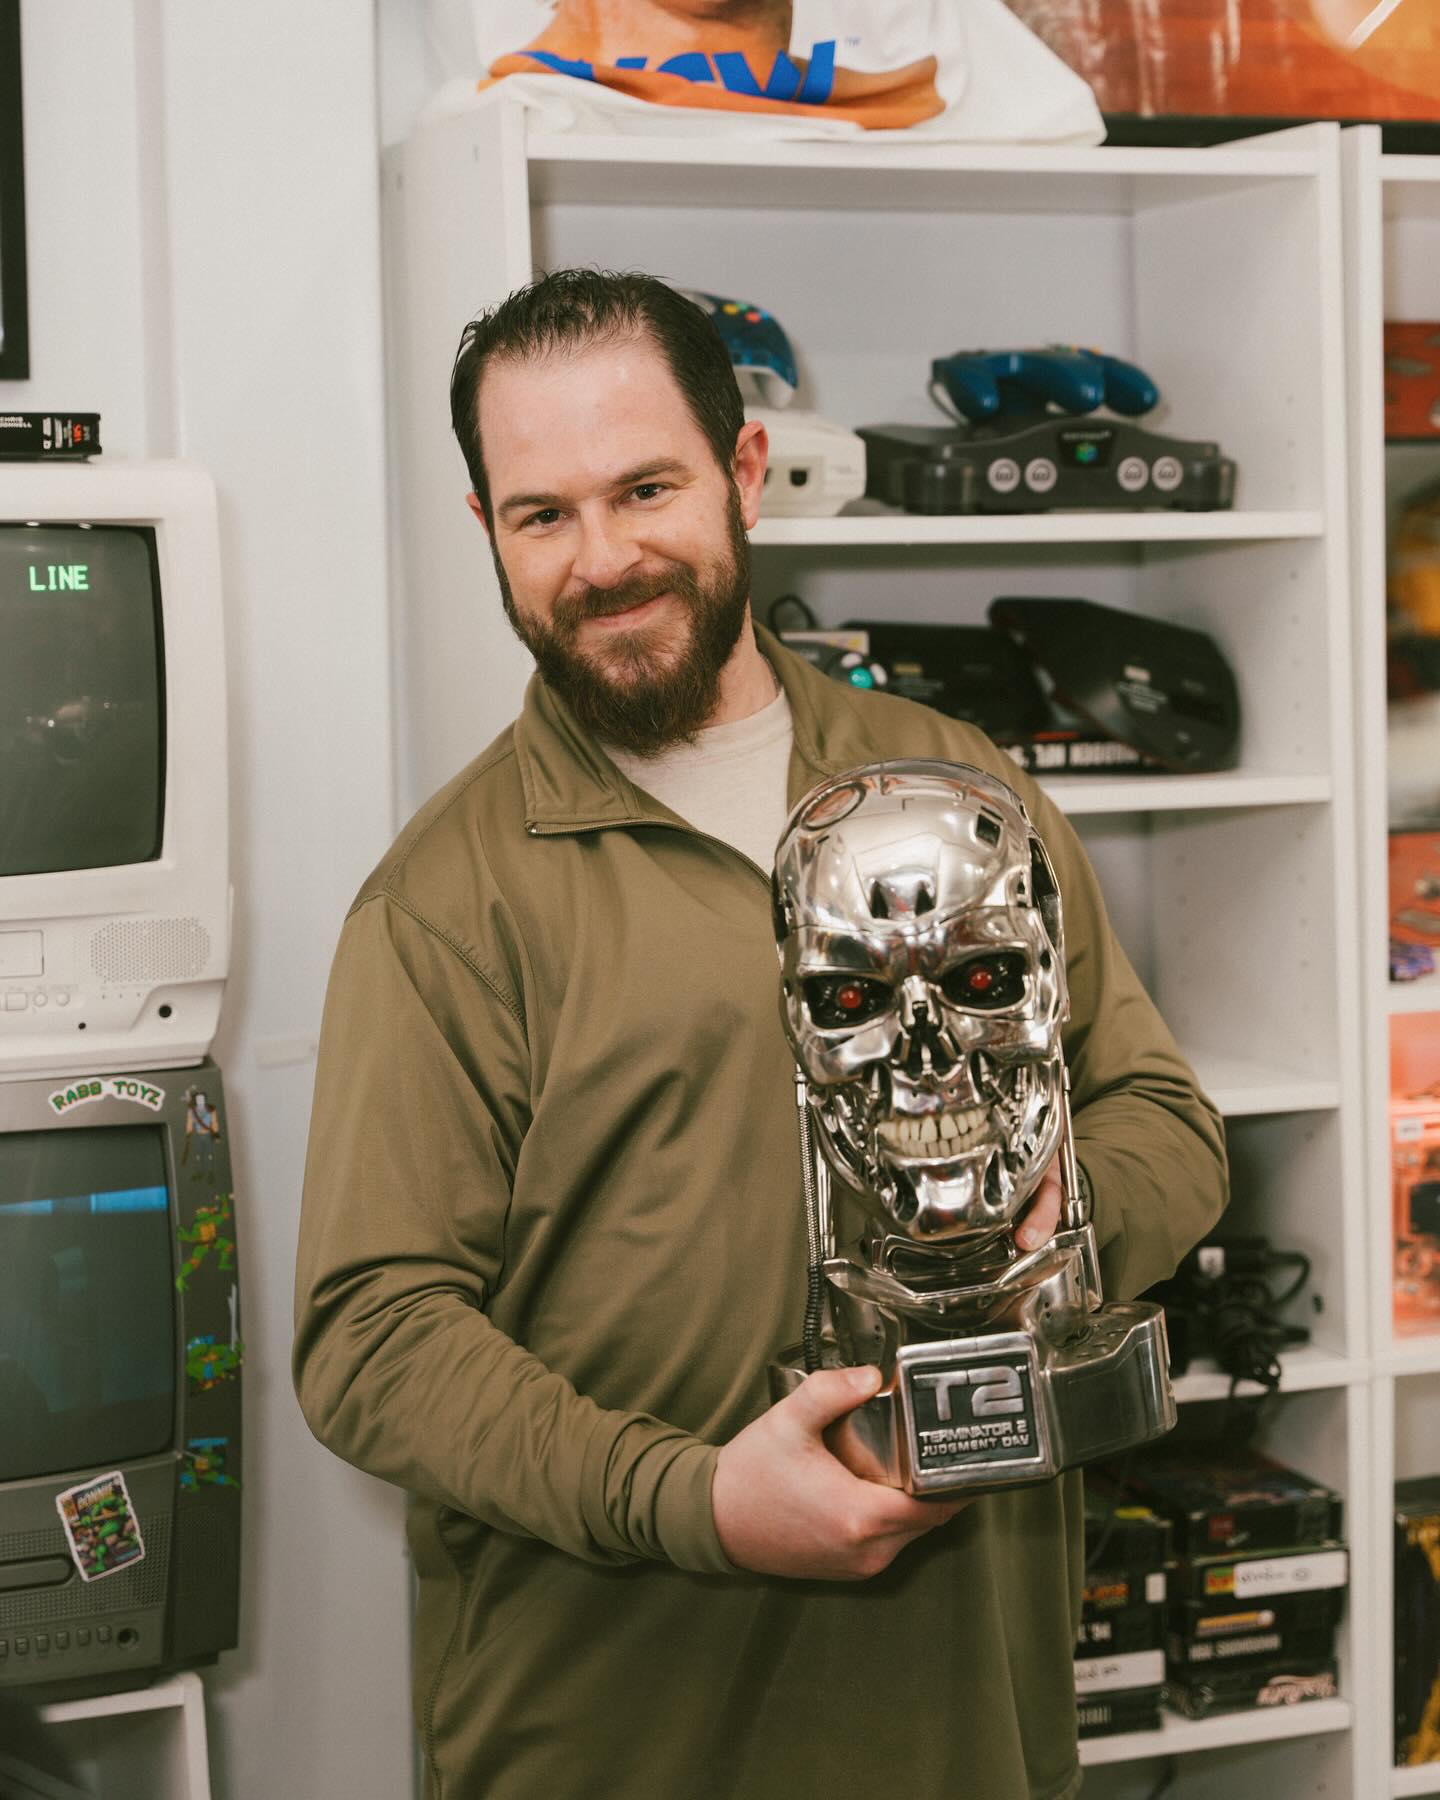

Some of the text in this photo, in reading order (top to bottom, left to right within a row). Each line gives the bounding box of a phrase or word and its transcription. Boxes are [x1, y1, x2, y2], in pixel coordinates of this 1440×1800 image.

[29, 565, 89, 591] LINE
[113, 1080, 160, 1106] TOYZ
[913, 1365, 1024, 1421] T2
[919, 1420, 1028, 1444] TERMINATOR 2
[921, 1434, 1030, 1457] JUDGMENT DAY
